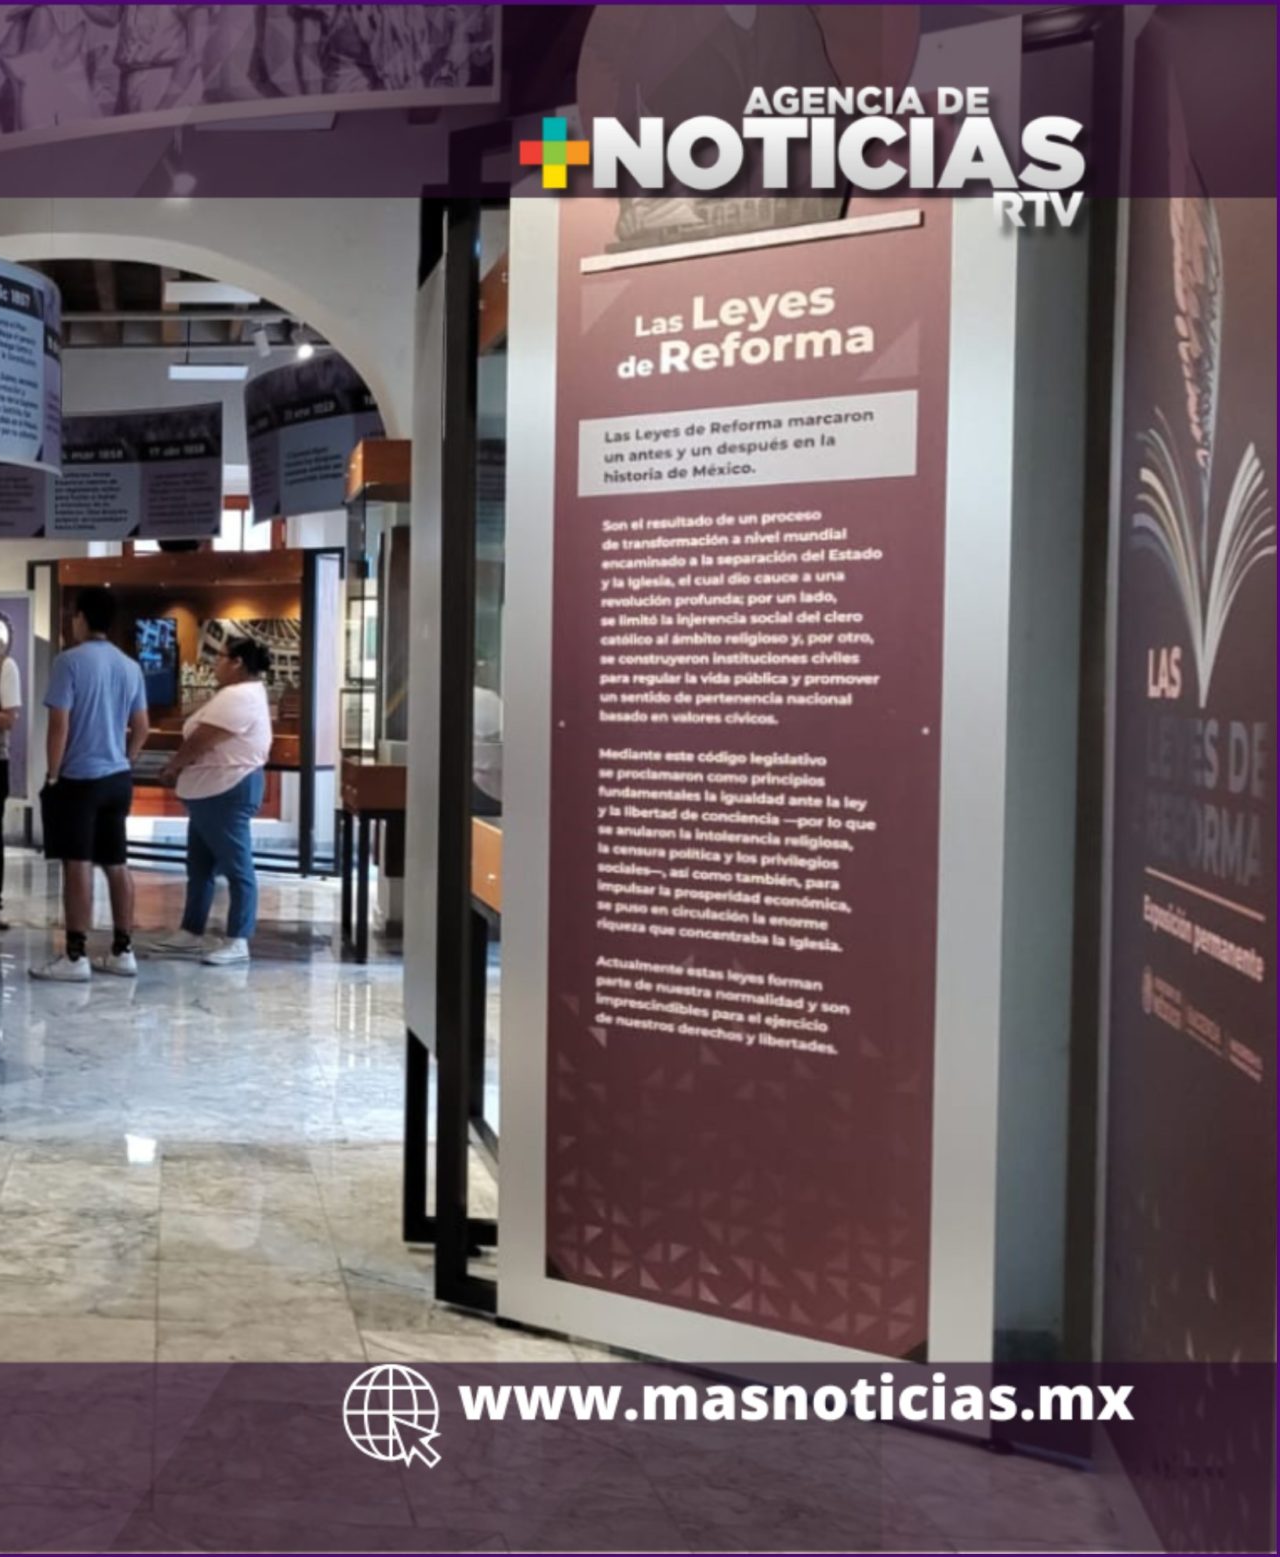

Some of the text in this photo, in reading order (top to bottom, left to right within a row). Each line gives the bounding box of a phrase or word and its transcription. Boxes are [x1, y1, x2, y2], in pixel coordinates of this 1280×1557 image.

[635, 285, 836, 338] Las Leyes
[617, 324, 875, 379] de Reforma
[604, 410, 874, 444] Las Leyes de Reforma marcaron
[603, 433, 836, 464] un antes y un después en la
[603, 461, 756, 483] historia de México.
[602, 510, 822, 532] Son el resultado de un proceso
[601, 538, 619, 551] de
[731, 534, 741, 545] a
[744, 530, 780, 544] nivel
[782, 527, 847, 542] mundial
[601, 554, 687, 569] encaminado
[688, 556, 698, 566] a
[700, 553, 714, 566] la
[800, 548, 825, 562] del
[828, 547, 883, 561] Estado
[747, 593, 773, 606] por
[775, 593, 797, 604] un
[600, 616, 616, 626] se
[660, 613, 674, 625] la
[676, 611, 747, 628] injerencia
[749, 610, 793, 624] social
[795, 610, 821, 623] del
[823, 609, 863, 623] clero
[655, 632, 669, 645] al
[724, 631, 789, 647] religioso
[806, 633, 834, 646] por
[600, 651, 860, 667] se construyeron instituciones civiles
[599, 674, 630, 685] para
[632, 671, 681, 686] regular
[684, 672, 698, 684] la
[700, 671, 731, 684] vida
[791, 675, 801, 687] y
[803, 674, 880, 687] promover
[1147, 646, 1182, 699] LAS
[599, 690, 852, 706] un sentido de pertenencia nacional
[599, 709, 648, 722] basado
[650, 712, 669, 722] en
[671, 710, 722, 724] valores
[598, 747, 662, 761] Mediante
[664, 750, 695, 762] este
[749, 751, 827, 767] legislativo
[1228, 719, 1267, 799] DE
[598, 767, 826, 788] se proclamaron como principios
[598, 785, 867, 812] fundamentales la igualdad ante la ley
[598, 824, 613, 835] se
[615, 824, 676, 839] anularon
[678, 827, 692, 840] la
[694, 827, 781, 846] intolerancia
[597, 842, 610, 854] la
[612, 844, 666, 858] censura
[723, 852, 733, 865] y
[735, 850, 758, 864] los
[760, 852, 839, 871] privilegios
[596, 917, 646, 933] riqueza
[648, 923, 676, 936] que
[678, 927, 769, 945] concentraba
[772, 933, 786, 947] la
[596, 955, 823, 991] Actualmente estas leyes forman
[595, 992, 828, 1033] imprescindibles para el ejercicio
[595, 1011, 613, 1024] de
[615, 1015, 675, 1033] nuestros
[677, 1022, 744, 1042] derechos
[745, 1033, 756, 1046] y
